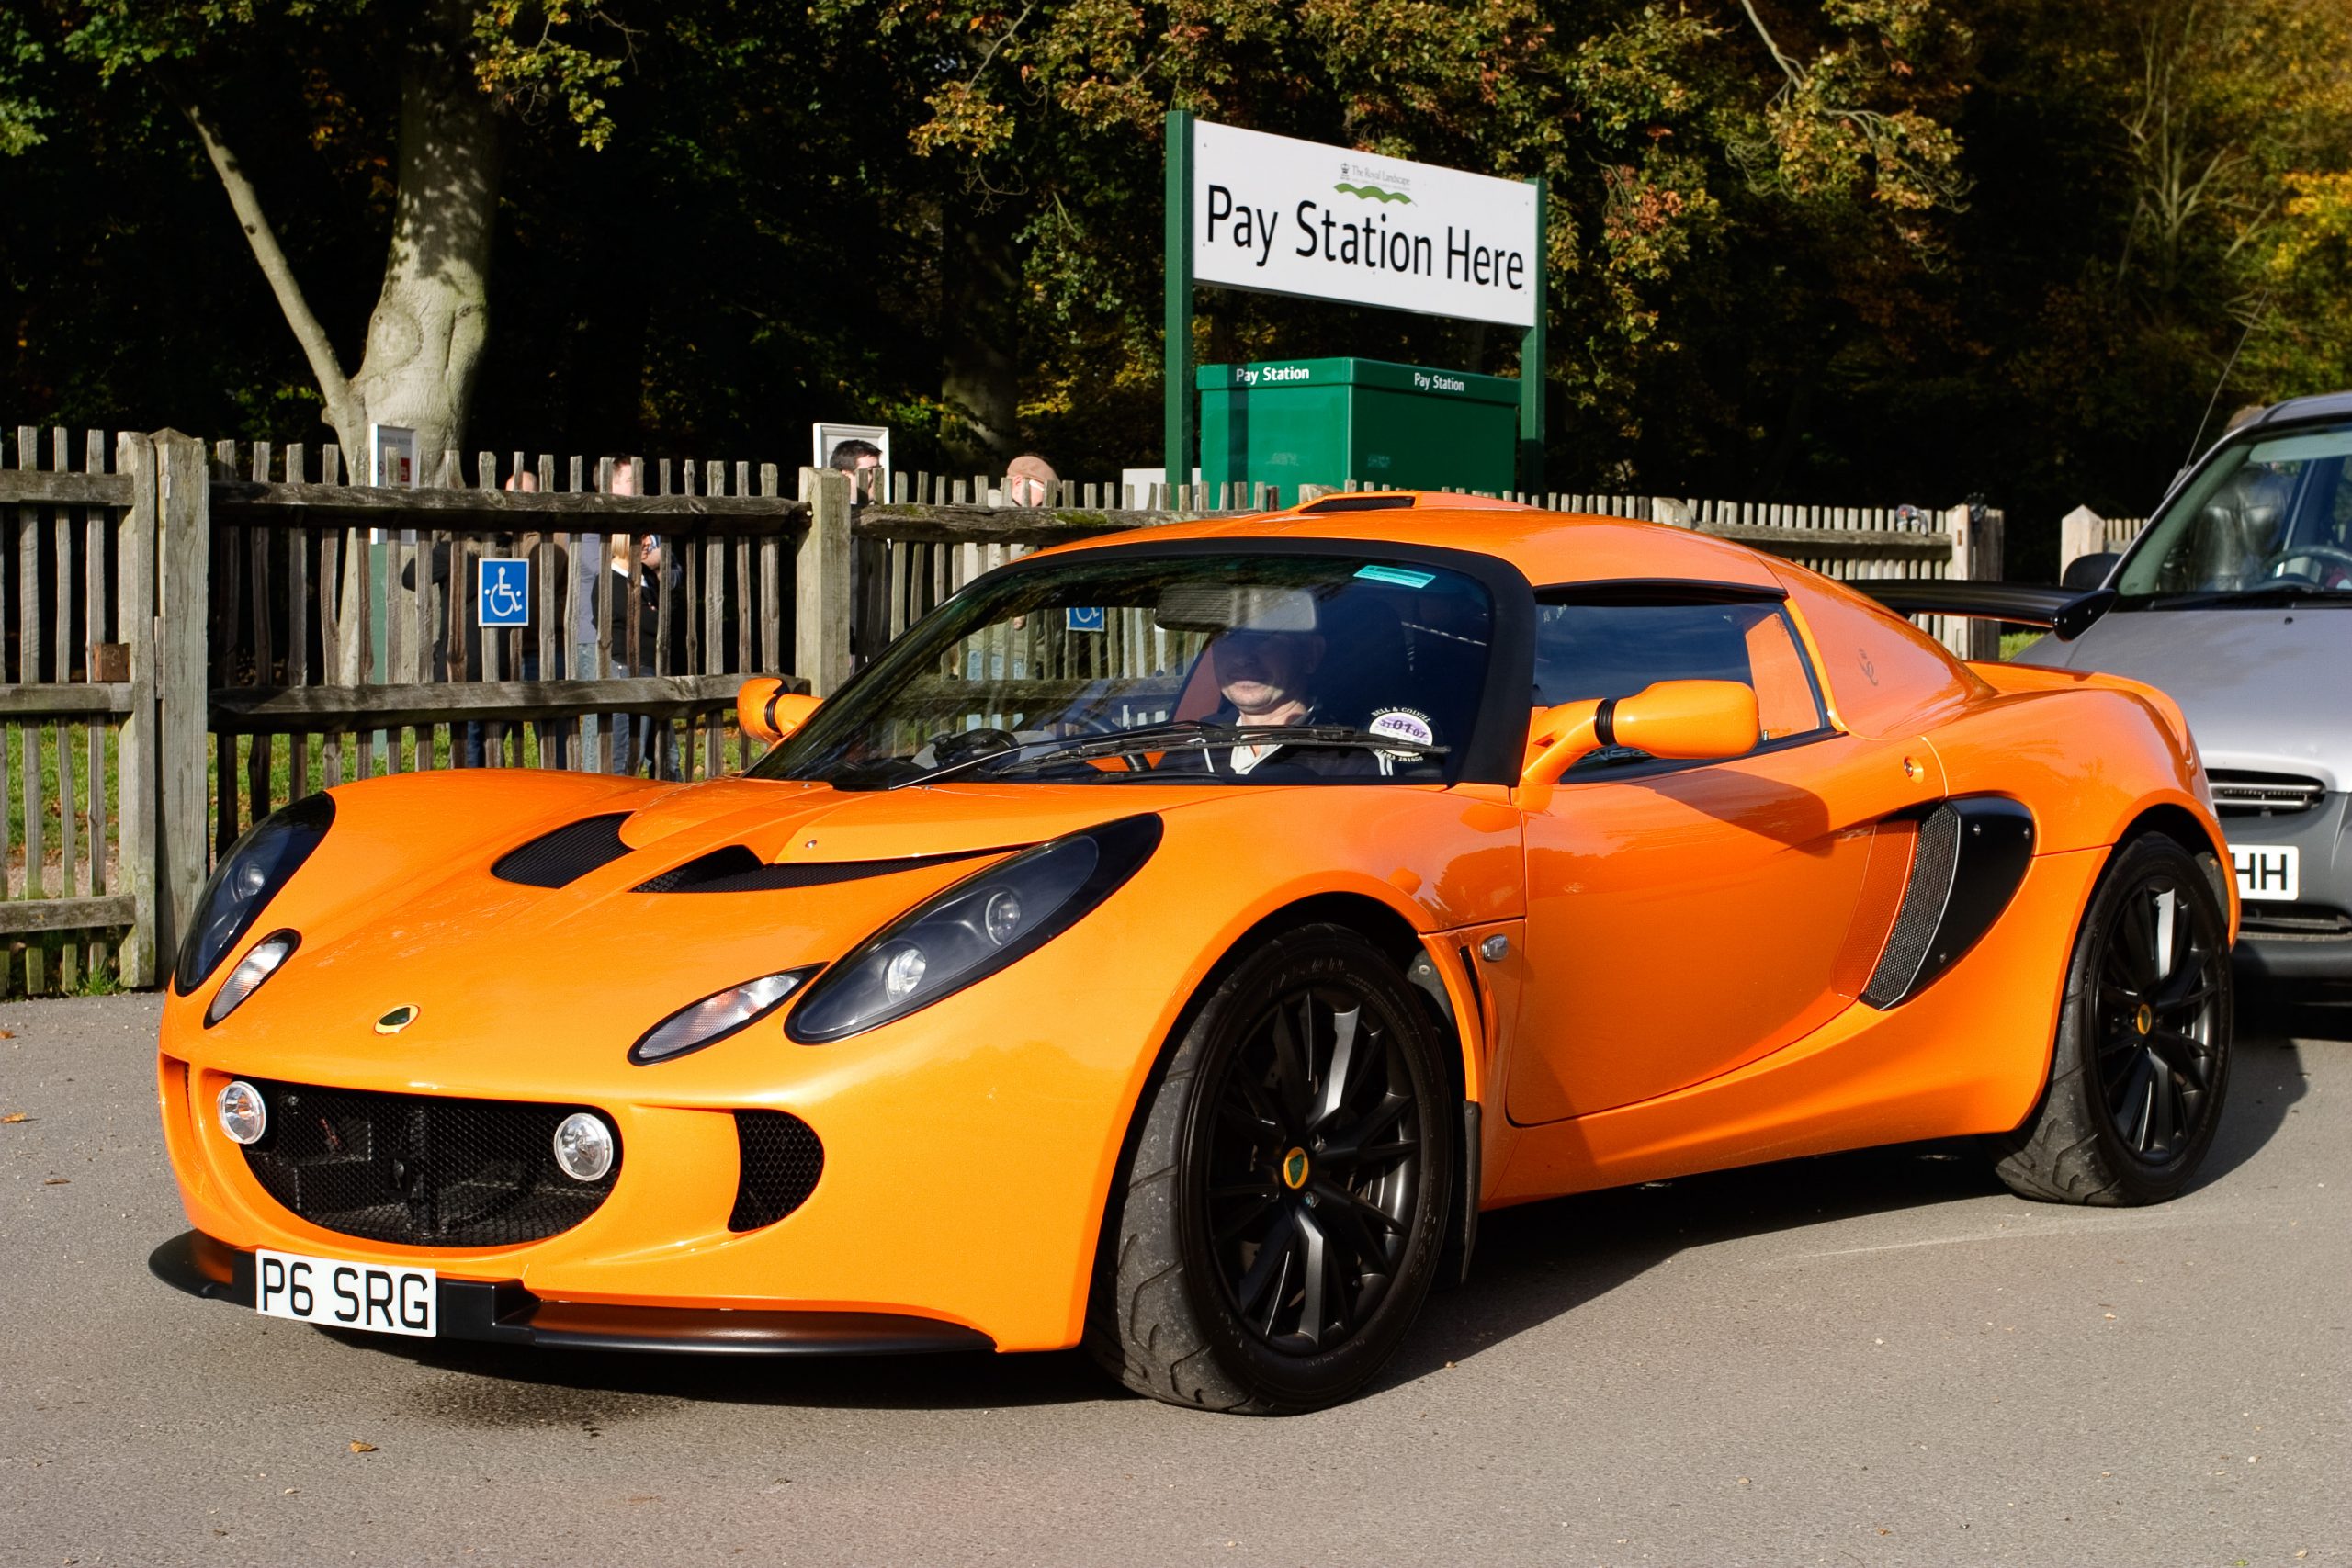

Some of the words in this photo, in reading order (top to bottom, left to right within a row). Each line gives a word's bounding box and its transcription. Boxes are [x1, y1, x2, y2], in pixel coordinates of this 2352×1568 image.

[1207, 184, 1279, 267] Pay
[1295, 199, 1432, 276] Station
[1447, 226, 1524, 290] Here
[1236, 368, 1259, 385] Pay
[1263, 366, 1309, 381] Station
[1414, 372, 1430, 391] Pay
[1433, 375, 1464, 392] Station
[263, 1258, 313, 1316] P6
[334, 1267, 428, 1330] SRG
